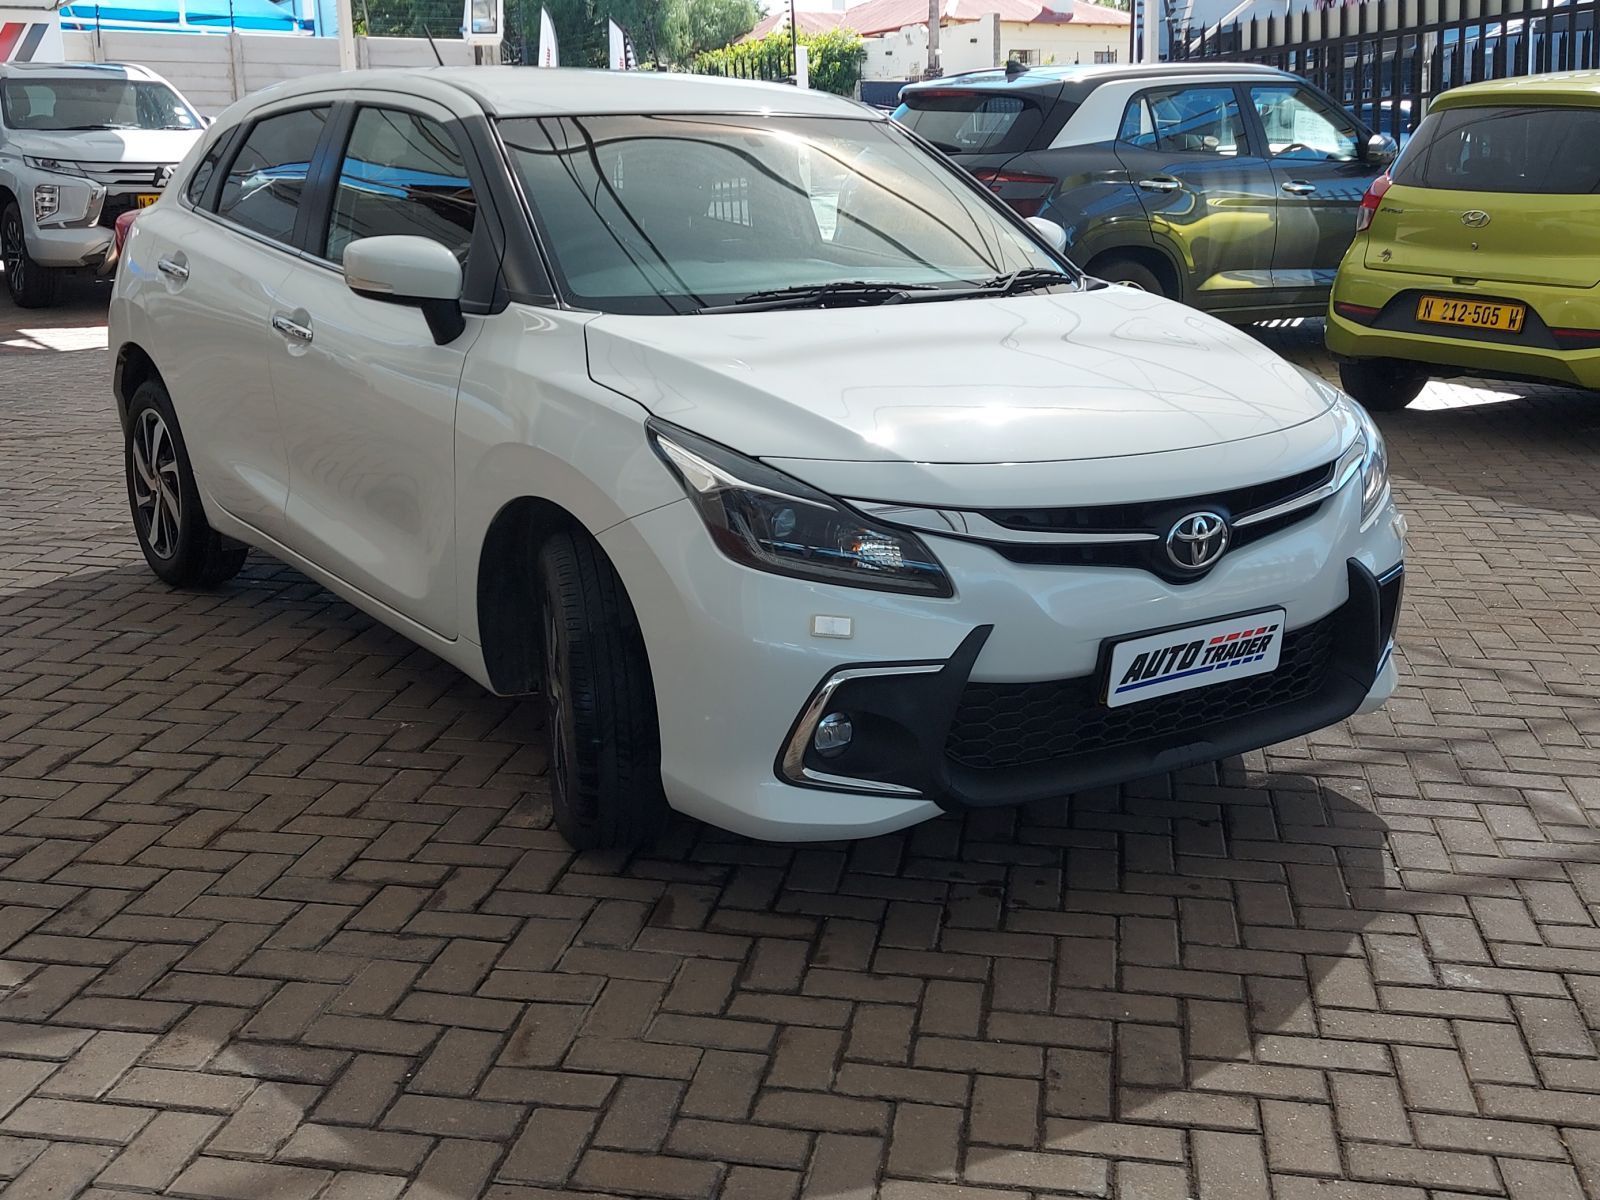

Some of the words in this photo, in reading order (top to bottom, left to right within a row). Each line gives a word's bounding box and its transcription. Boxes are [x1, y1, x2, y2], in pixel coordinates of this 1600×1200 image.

[1423, 300, 1434, 319] N
[1441, 302, 1502, 326] 212-505
[1119, 639, 1206, 685] AUTO
[1201, 634, 1274, 666] TRADER
